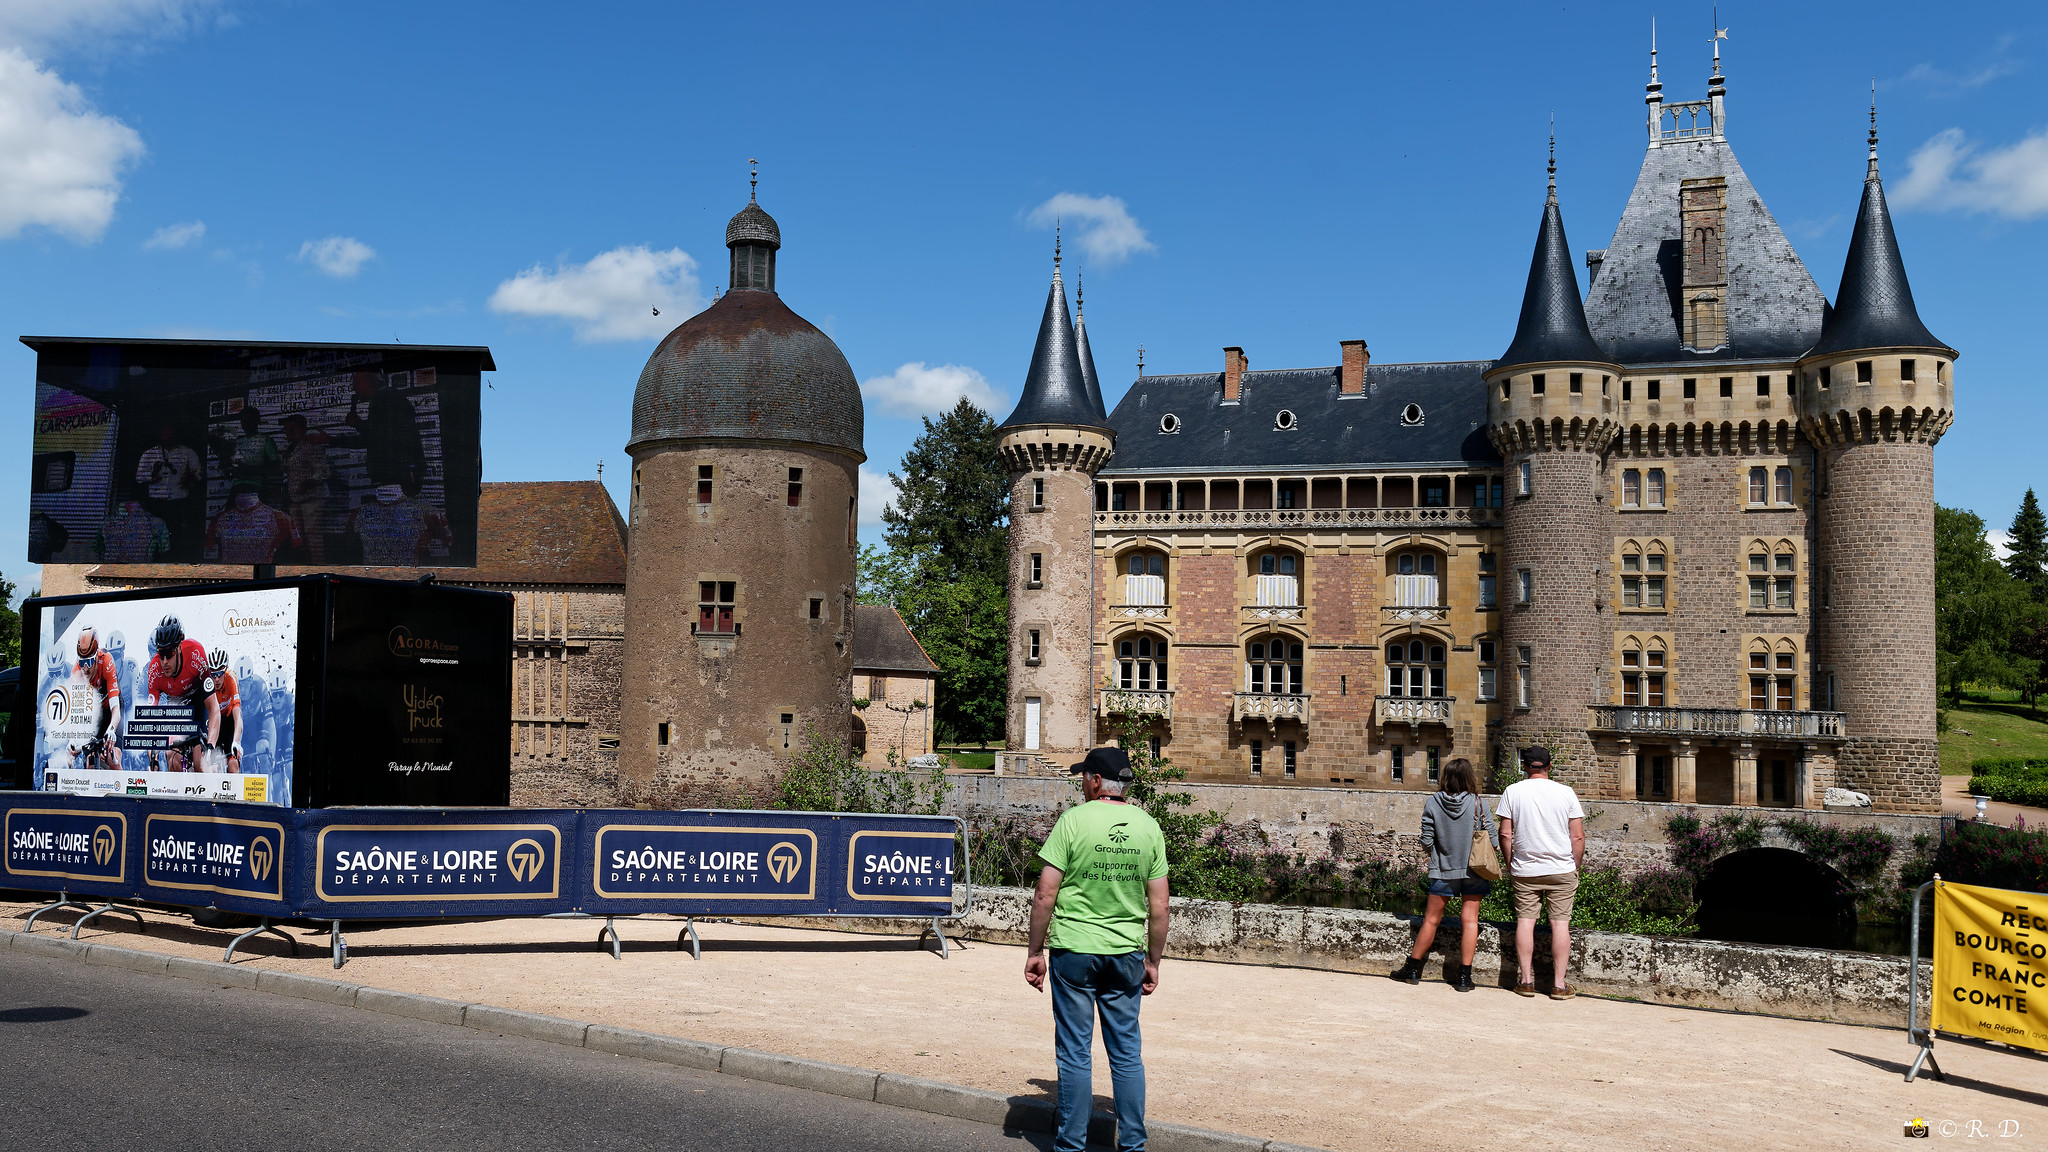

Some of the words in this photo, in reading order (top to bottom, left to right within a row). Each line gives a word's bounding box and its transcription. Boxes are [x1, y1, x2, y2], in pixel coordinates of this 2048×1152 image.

[226, 616, 260, 630] AGORA
[394, 634, 439, 650] AGORA
[52, 701, 63, 720] 71
[407, 705, 443, 732] Truck
[388, 761, 413, 776] Paray
[421, 761, 453, 772] Monial
[184, 784, 206, 795] PVP
[13, 827, 53, 850] SAÔNE
[55, 836, 59, 845] &
[60, 832, 90, 852] LOIRE
[152, 835, 195, 860] SAÔNE
[197, 845, 204, 855] &
[206, 842, 245, 865] LOIRE
[612, 845, 685, 870] SAÔNE
[688, 854, 696, 865] &
[700, 851, 759, 870] LOIRE
[1094, 844, 1141, 855] Groupama
[335, 845, 417, 871] SAÔNE
[420, 854, 429, 865] &
[432, 850, 498, 870] LOIRE
[864, 850, 932, 874] SAÔNE
[934, 859, 942, 869] &
[1092, 861, 1139, 872] supporter
[335, 873, 497, 885] DÉPARTEMENT
[611, 871, 758, 883] DÉPARTEMENT
[1082, 870, 1099, 880] des
[1101, 871, 1142, 882] béévole
[1955, 931, 2047, 959] BOURGO
[1972, 962, 2046, 988] FRANC
[1979, 1020, 1992, 1029] Ma
[1994, 1023, 2025, 1035] Région
